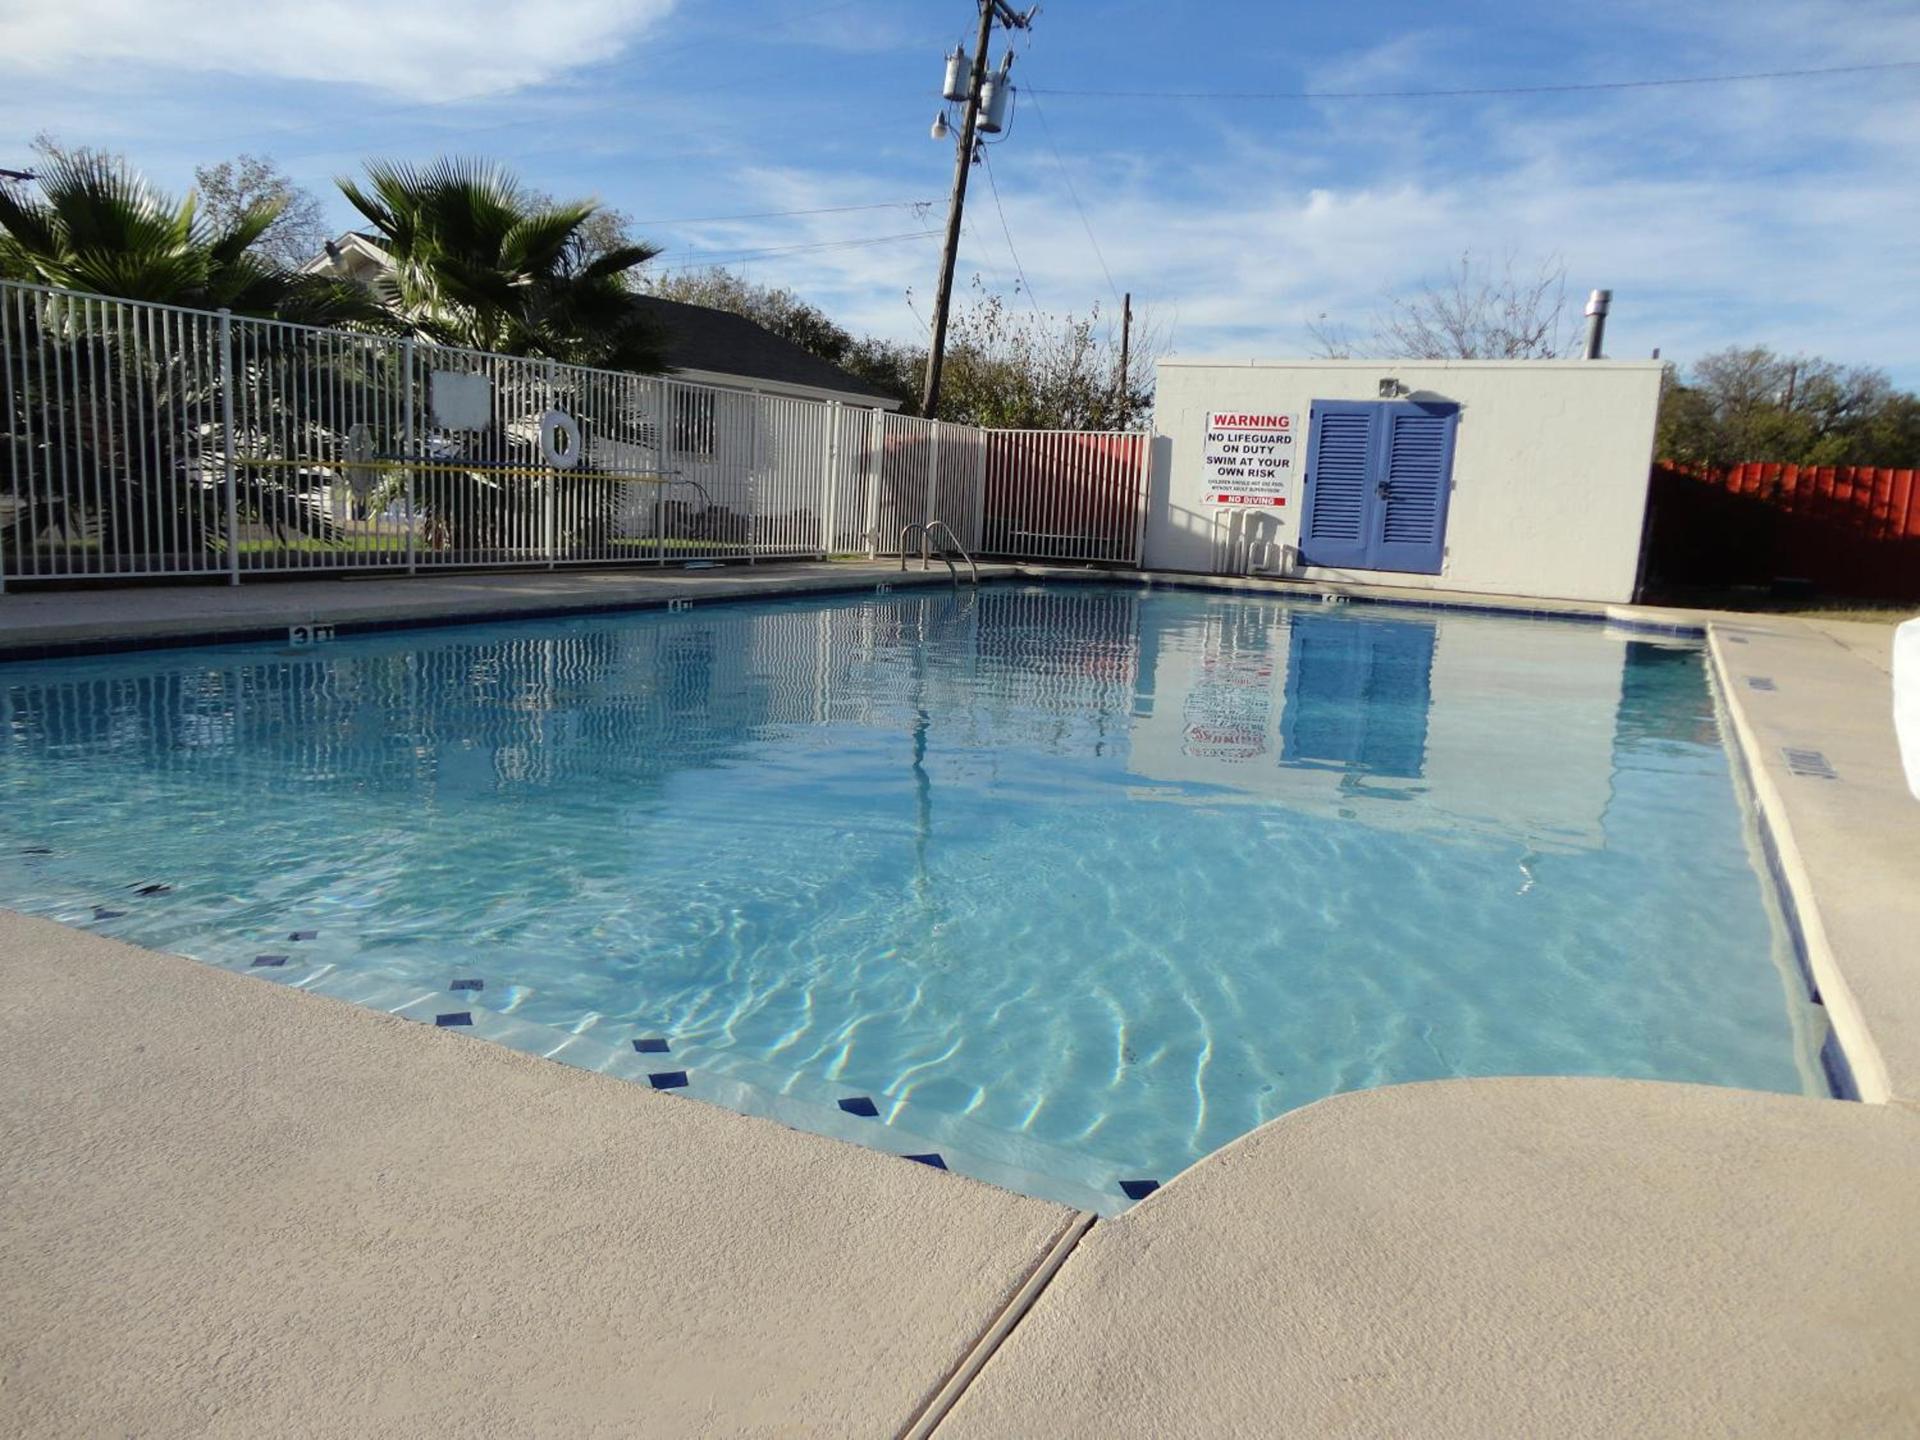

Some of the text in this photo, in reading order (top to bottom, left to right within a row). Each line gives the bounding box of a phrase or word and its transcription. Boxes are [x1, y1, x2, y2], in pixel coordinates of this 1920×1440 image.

[1214, 414, 1289, 427] WARNING
[1208, 433, 1292, 444] NO LIFEGUARD
[1222, 445, 1275, 454] ON DUTY
[1206, 456, 1290, 468] SWIM AT YOUR
[1217, 467, 1276, 478] OWN RISK
[1228, 495, 1275, 505] NO DIVING
